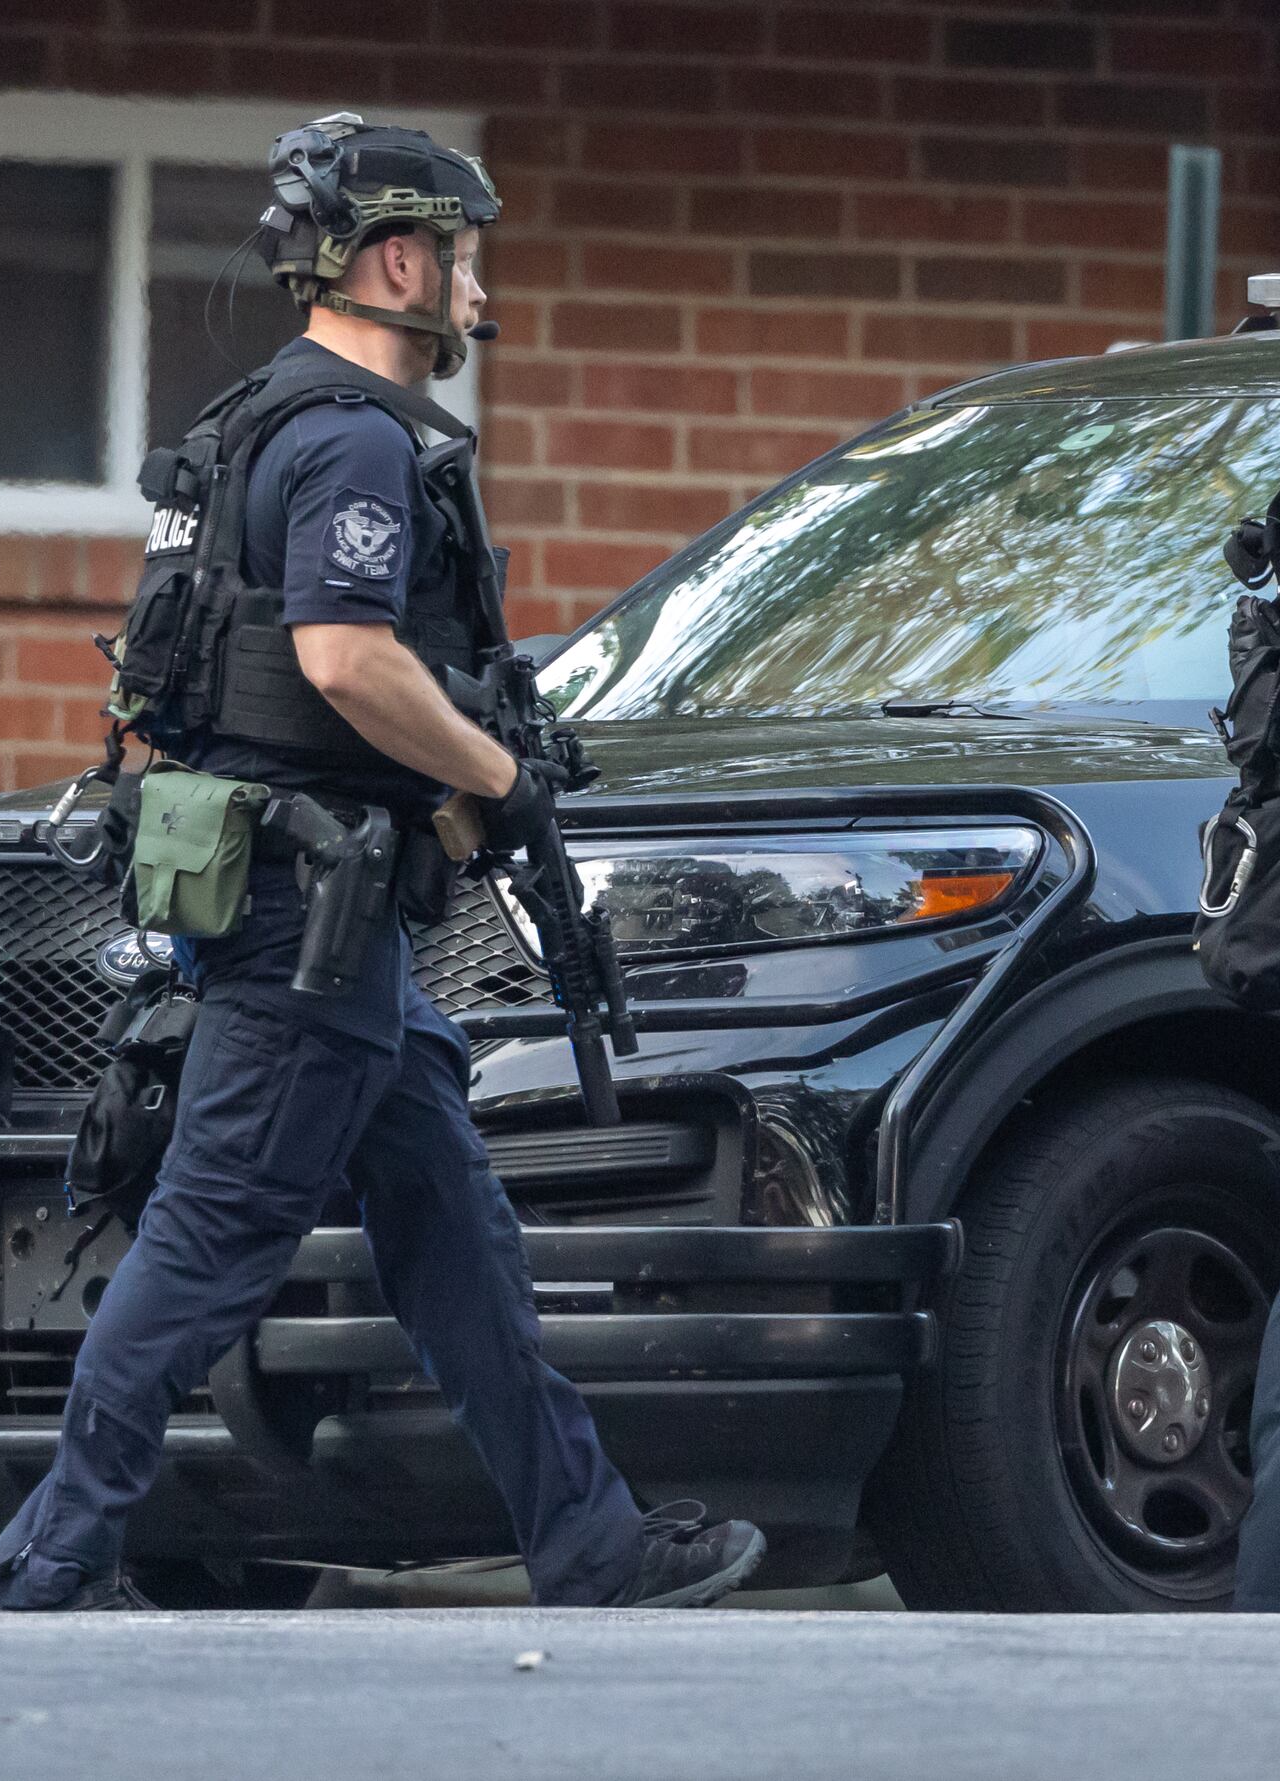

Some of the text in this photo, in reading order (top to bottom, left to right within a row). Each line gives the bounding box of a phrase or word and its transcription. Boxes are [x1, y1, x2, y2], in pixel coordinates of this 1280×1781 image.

[145, 503, 199, 553] POLICE
[332, 549, 390, 576] SWAT TEAM
